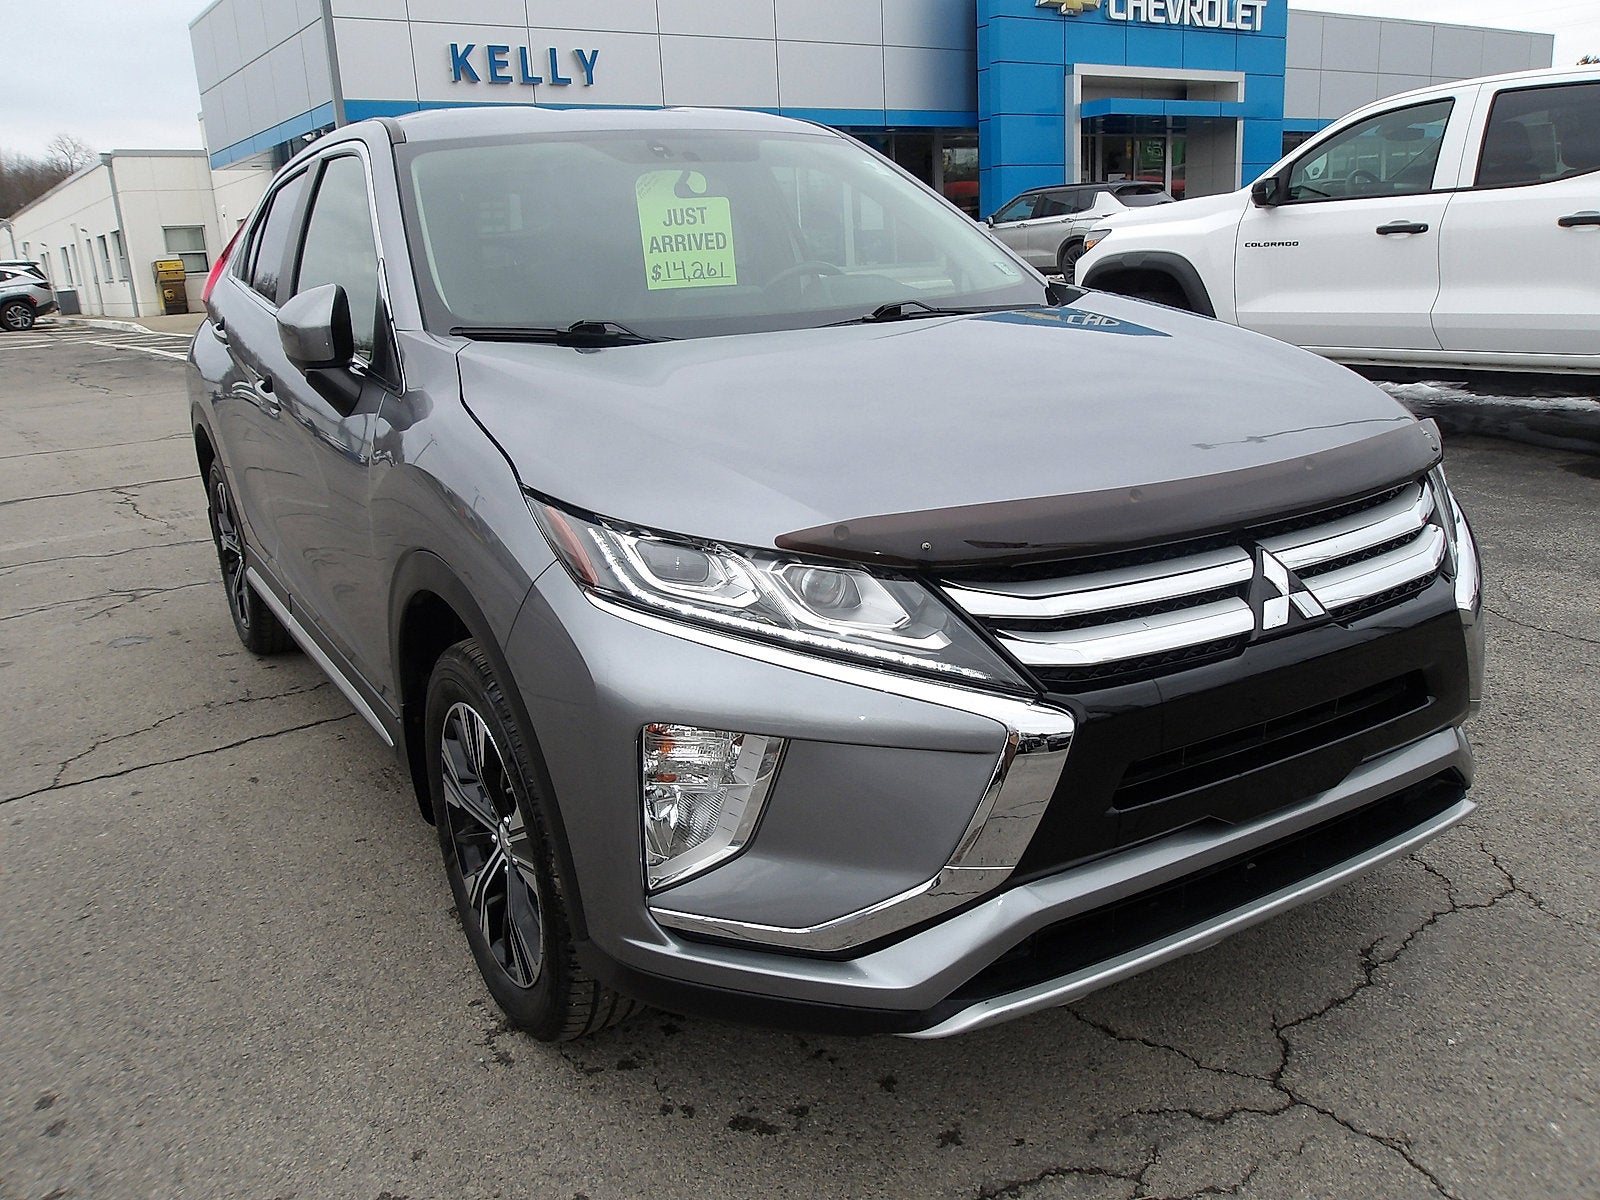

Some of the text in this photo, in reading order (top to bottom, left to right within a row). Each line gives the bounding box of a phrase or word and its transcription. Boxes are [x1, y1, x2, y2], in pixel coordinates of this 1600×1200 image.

[1106, 0, 1267, 32] CHEVROLET
[449, 42, 599, 86] KELLY
[662, 206, 707, 227] JUST
[649, 232, 727, 254] ARRIVED
[651, 261, 726, 282] $14,261
